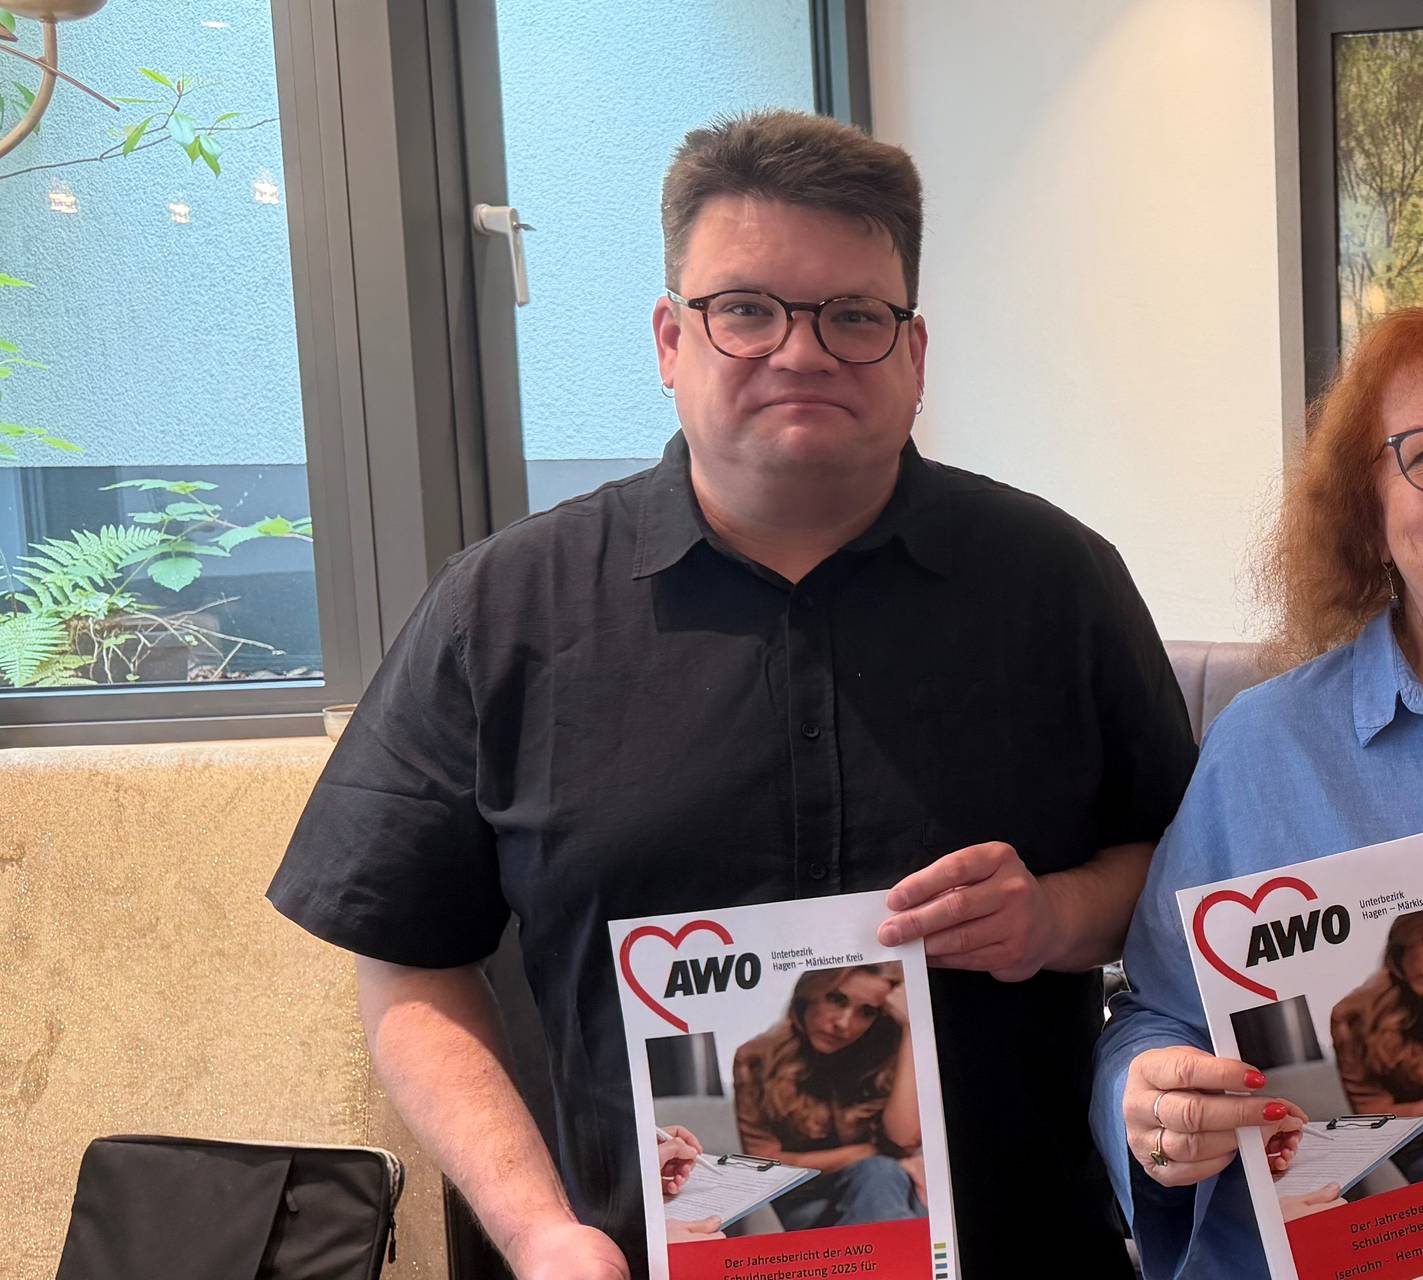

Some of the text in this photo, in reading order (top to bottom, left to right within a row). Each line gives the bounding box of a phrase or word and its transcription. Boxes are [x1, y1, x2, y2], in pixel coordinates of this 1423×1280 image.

[1359, 890, 1405, 909] Unterbezirk
[1362, 908, 1388, 920] Hagen
[1245, 904, 1351, 968] AWO
[771, 947, 814, 960] Unterbezirk
[772, 961, 797, 971] Hagen
[805, 956, 844, 967] Märkischer
[845, 952, 864, 962] Kreis
[663, 952, 762, 999] AWO
[1350, 1221, 1371, 1234] Der
[724, 1244, 874, 1268] Der Jahresbericht der AWO
[831, 1262, 857, 1275] 2025
[861, 1260, 877, 1271] für
[1335, 1259, 1382, 1280] Iserlohn
